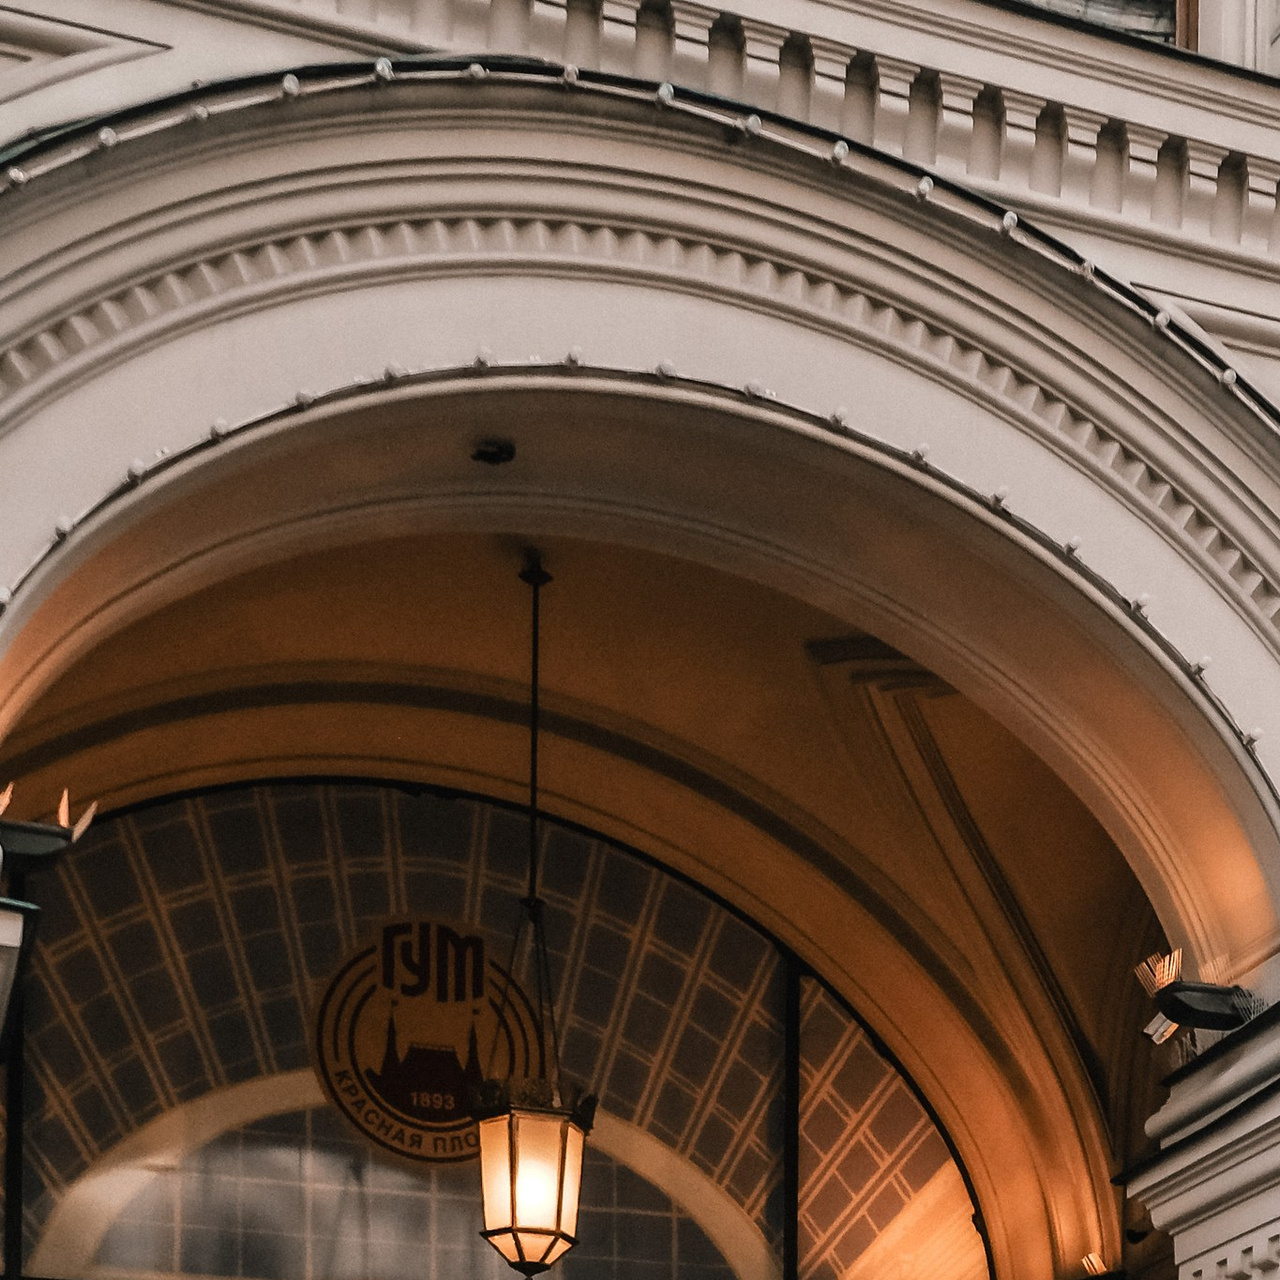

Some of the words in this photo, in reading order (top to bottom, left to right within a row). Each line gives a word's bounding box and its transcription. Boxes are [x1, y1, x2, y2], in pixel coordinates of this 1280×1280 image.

[382, 923, 484, 1002] ГУМ
[334, 1069, 423, 1149] КРАСНАЯ
[411, 1092, 455, 1110] 1893
